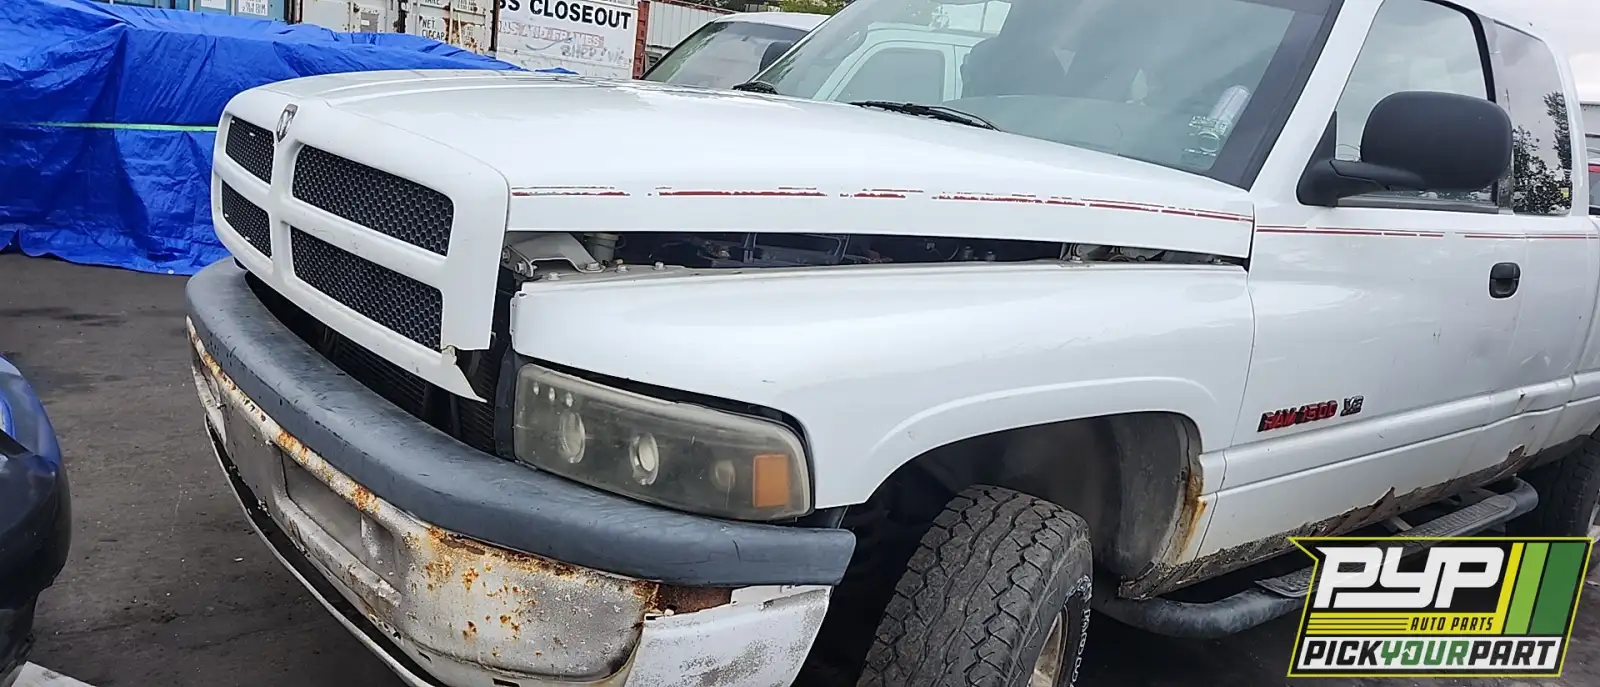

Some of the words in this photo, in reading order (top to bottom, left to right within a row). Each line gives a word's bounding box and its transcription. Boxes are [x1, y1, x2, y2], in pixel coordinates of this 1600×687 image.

[529, 0, 632, 29] CLOSEOUT
[1257, 407, 1297, 432] RAM
[1296, 400, 1338, 424] 1500
